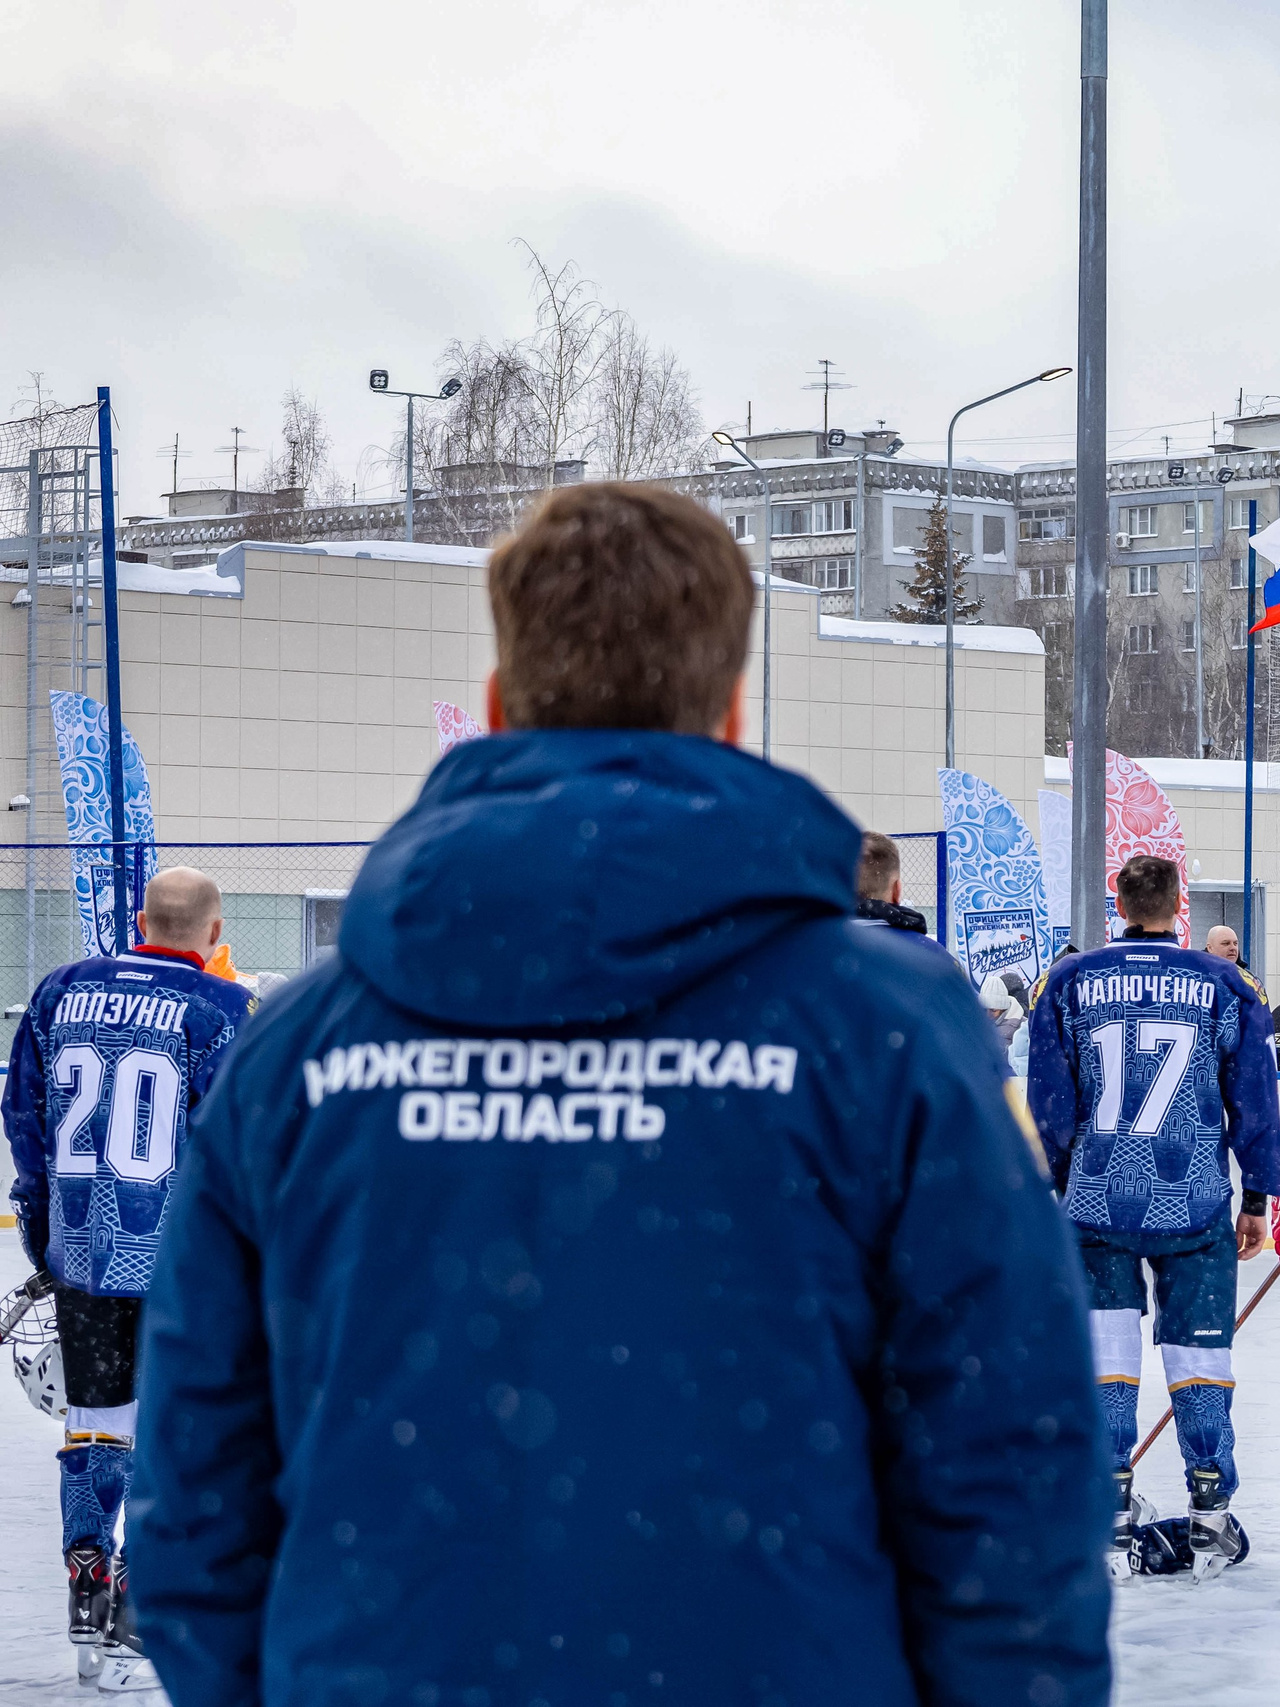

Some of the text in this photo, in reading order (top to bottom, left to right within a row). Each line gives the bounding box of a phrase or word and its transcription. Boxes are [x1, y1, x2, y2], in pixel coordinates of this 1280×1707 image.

[968, 913, 1030, 924] ОФИЦЕРСКАЯ
[1011, 921, 1032, 930] ЛИГА
[970, 938, 1035, 973] Русская
[1076, 975, 1215, 1008] МАЛЮЧЕНКО
[1090, 1020, 1198, 1136] 17
[52, 1042, 181, 1184] 20
[398, 1090, 667, 1142] ОБЛАСТЬ
